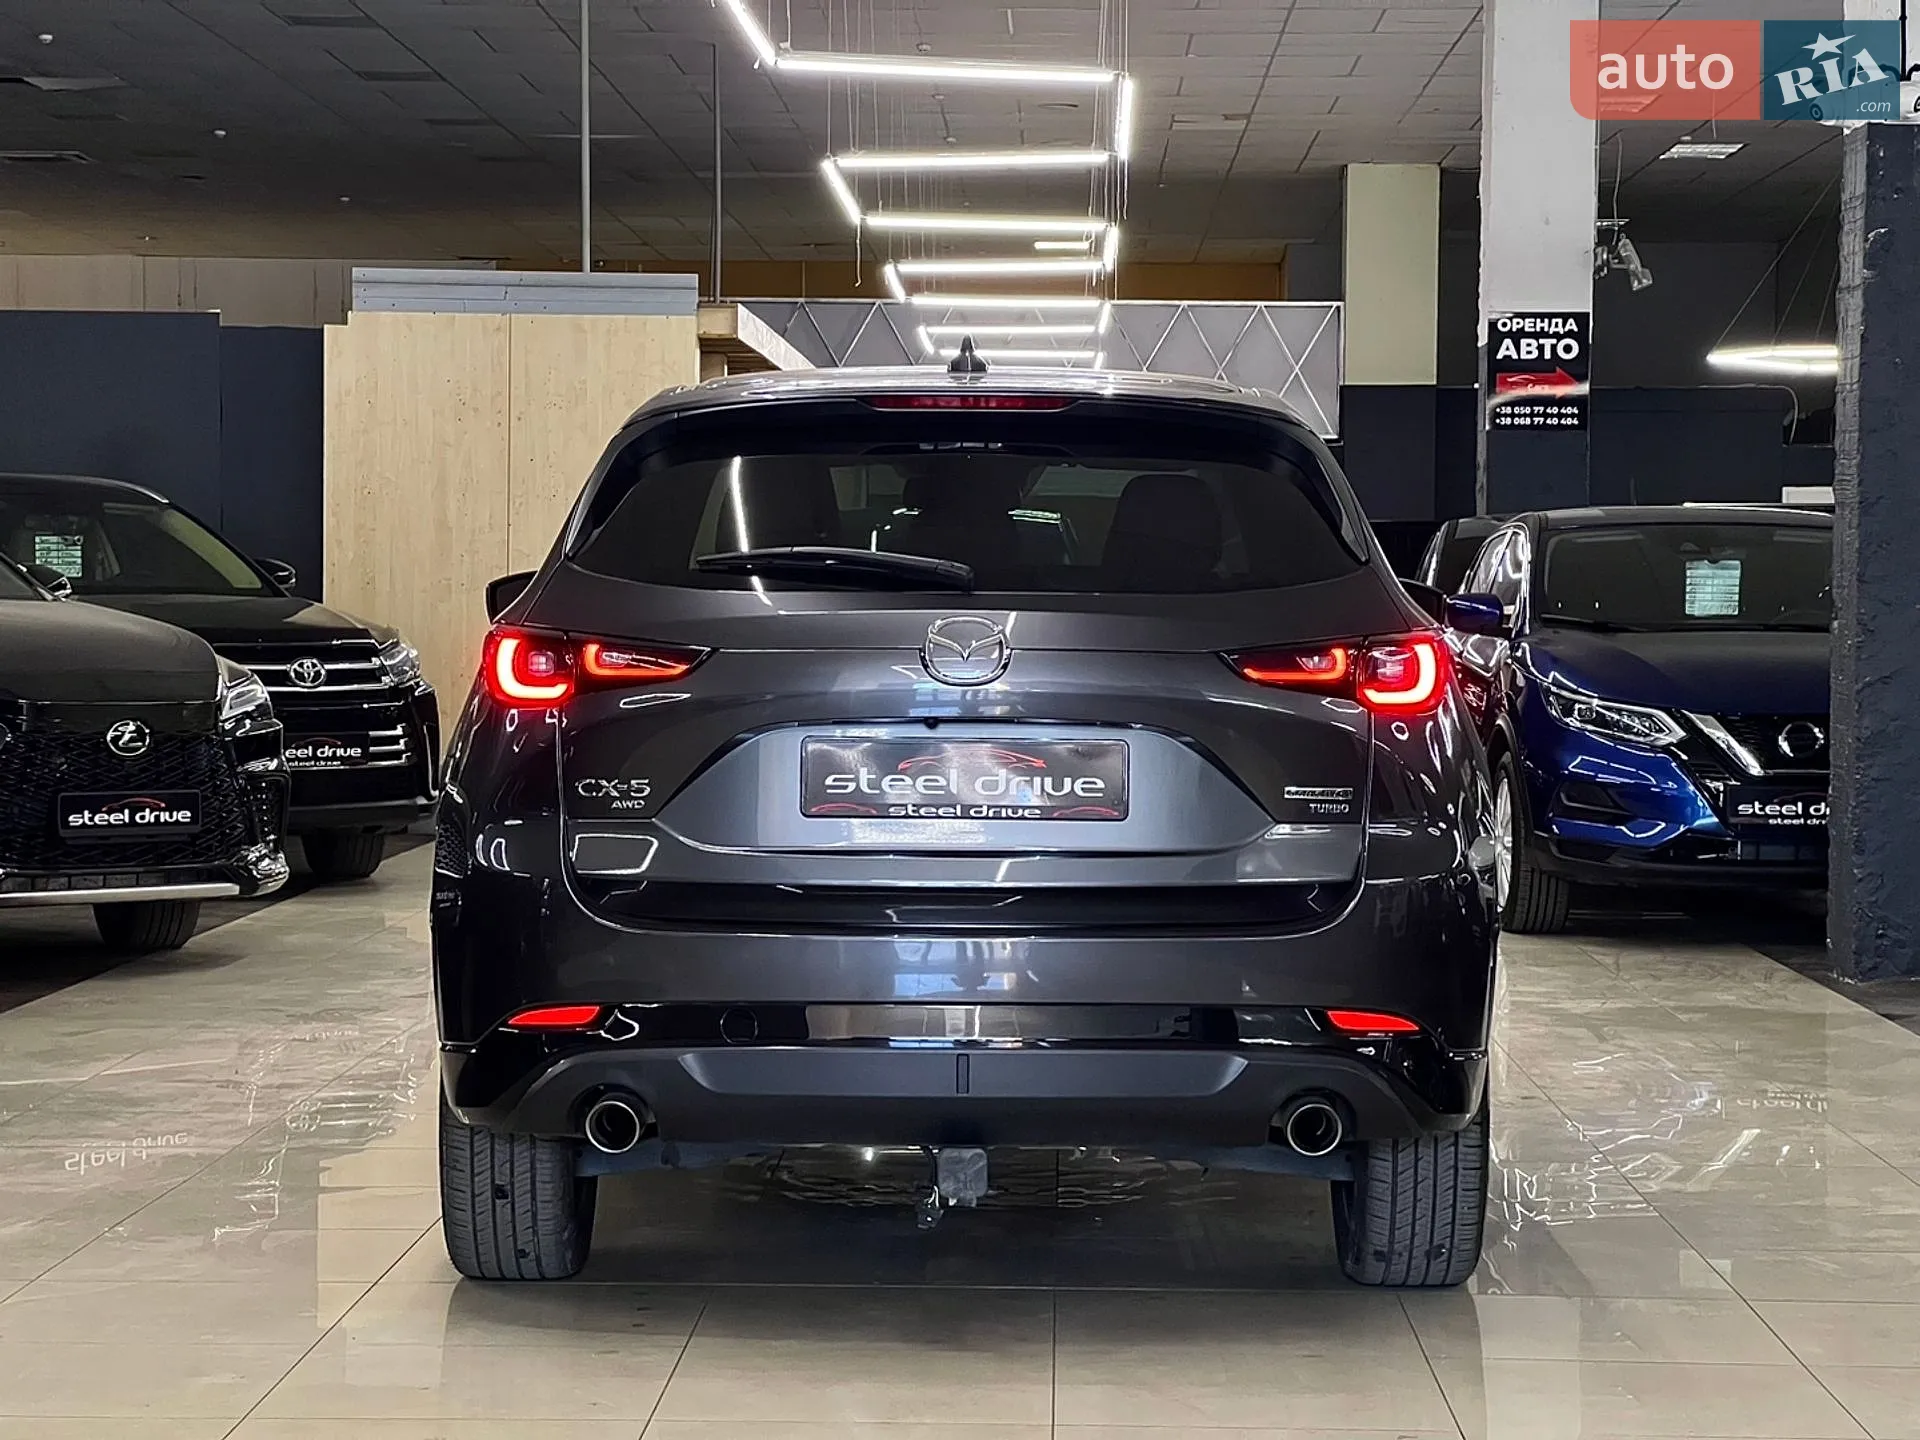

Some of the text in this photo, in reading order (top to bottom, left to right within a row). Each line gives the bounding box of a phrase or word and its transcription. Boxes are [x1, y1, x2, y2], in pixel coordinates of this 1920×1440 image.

[1497, 318, 1578, 335] ОРЕНДА
[1496, 338, 1579, 360] АВТО
[1533, 406, 1544, 414] 77
[1546, 406, 1558, 414] 40
[1560, 406, 1579, 414] 404
[1533, 417, 1544, 425] 77
[1546, 417, 1558, 425] 40
[1560, 417, 1579, 425] 404
[316, 745, 362, 757] drive
[577, 779, 651, 797] CX-5
[824, 768, 1106, 797] steel drive
[611, 800, 645, 809] AWD
[888, 804, 1041, 818] steel drive
[1309, 803, 1349, 813] TURBO
[1738, 801, 1803, 815] steel
[68, 808, 192, 826] steel drive
